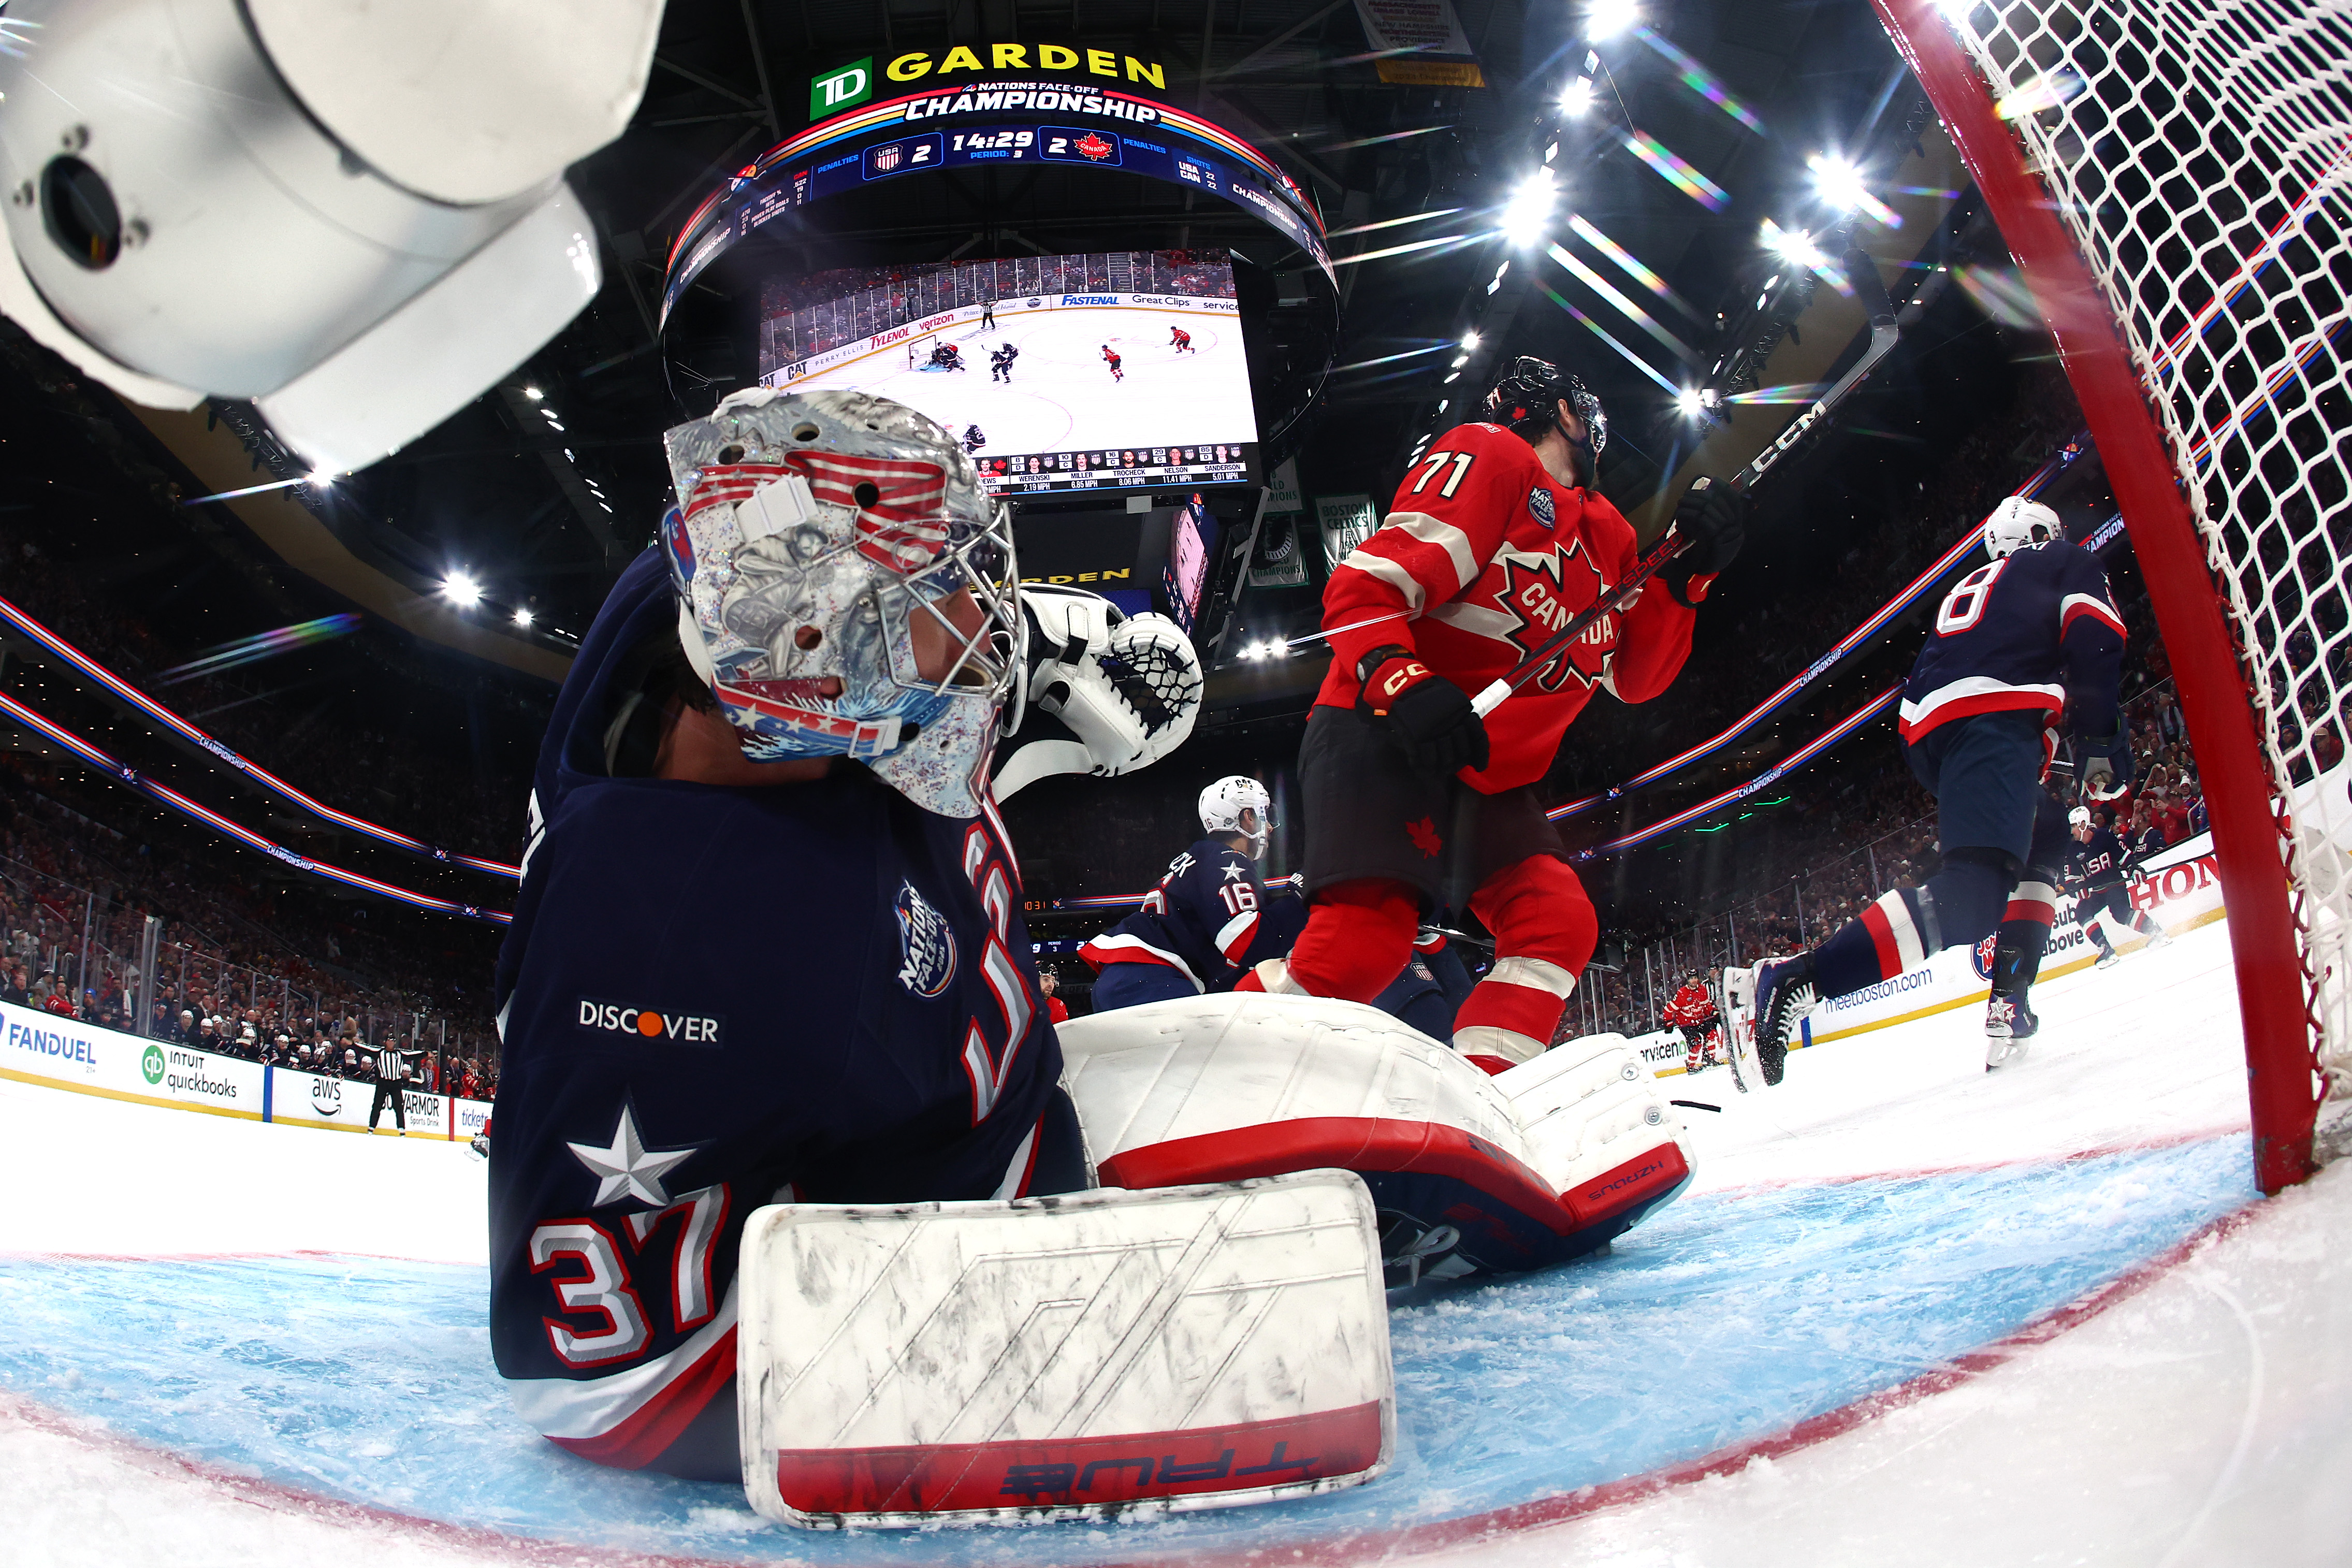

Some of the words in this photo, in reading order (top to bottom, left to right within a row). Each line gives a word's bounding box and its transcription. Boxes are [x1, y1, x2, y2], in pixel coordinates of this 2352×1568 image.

[886, 43, 1166, 90] GARDEN
[816, 68, 866, 106] TD
[978, 82, 1037, 92] NATIONS
[1038, 82, 1099, 95] FACE-OFF
[905, 91, 1156, 123] CHAMPIONSHIP
[878, 147, 898, 158] USA
[911, 144, 931, 163] 2
[953, 132, 1034, 152] 14:29
[1048, 137, 1068, 154] 2
[1079, 143, 1107, 154] CANADA
[1123, 138, 1167, 154] PENALTIES
[817, 154, 860, 174] PENALTIES
[970, 151, 1009, 159] PERIOD:
[1013, 150, 1023, 158] 3
[1186, 155, 1211, 171] SHOTS
[1178, 161, 1199, 175] USA
[1206, 171, 1216, 181] 22
[1180, 170, 1201, 184] CAN
[1207, 180, 1217, 191] 22
[1232, 183, 1298, 230] CHAMPIONSHIP
[1062, 295, 1120, 307] FASTENAL
[1132, 295, 1164, 306] Great
[1165, 297, 1190, 307] Clips
[919, 313, 954, 331] verizon
[870, 327, 910, 351] TYLENOL
[815, 354, 840, 367] PERRY
[843, 344, 864, 357] ELLIS
[788, 361, 807, 381] CAT
[1751, 401, 1827, 473] CCM
[1071, 481, 1085, 489] 6.85
[1163, 475, 1179, 484] 11.41
[1179, 474, 1192, 483] MPH
[1225, 472, 1239, 480] MPH
[1412, 450, 1476, 499] 71
[1322, 503, 1368, 517] BOSTON
[1530, 487, 1554, 510] NATIO
[1327, 516, 1369, 530] CELTICS
[968, 567, 1130, 591] ARDEN
[1252, 564, 1301, 578] CHAMPIONS
[1587, 532, 1683, 620] JETSPEED
[1935, 557, 2009, 638] 8
[1799, 648, 1842, 687] CHAMPIONSHIP
[199, 736, 246, 770] CHAMPIONSHIP
[1738, 766, 1783, 798] CHAMPIONSHIP
[1204, 818, 1213, 829] 16
[267, 844, 314, 871] CHAMPIONSHIP
[2081, 852, 2111, 878] USA
[1218, 881, 1260, 916] 16
[898, 885, 926, 991] NATIONS
[937, 943, 946, 972] 2025
[1825, 967, 1933, 1014] meetboston.com
[579, 1000, 719, 1043] DISCOVER
[9, 1023, 96, 1064] FANDUEL
[170, 1051, 205, 1070] INTUIT
[168, 1072, 237, 1098] quickbooks
[312, 1078, 341, 1101] aws
[410, 1115, 426, 1126] Sports
[427, 1117, 439, 1127] Drink
[527, 1182, 731, 1370] 37
[999, 1440, 1319, 1498] TRUE
